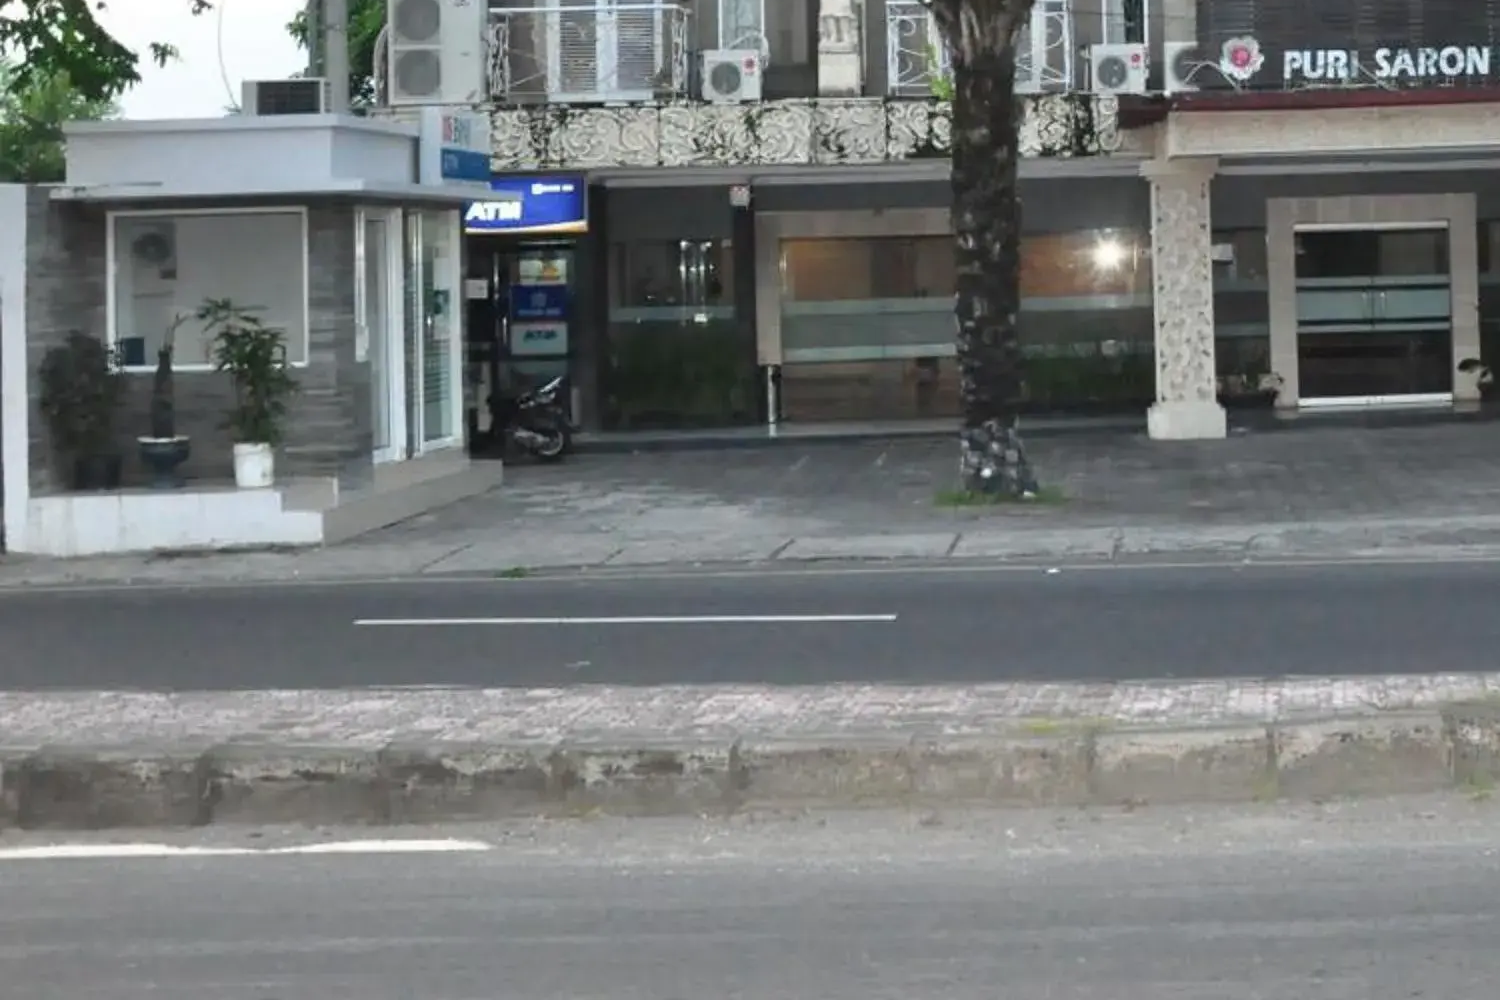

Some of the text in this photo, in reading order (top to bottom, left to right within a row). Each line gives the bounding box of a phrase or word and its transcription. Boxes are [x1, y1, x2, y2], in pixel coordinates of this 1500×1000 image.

[1283, 49, 1359, 79] PURI
[1375, 47, 1489, 77] SARON
[465, 201, 522, 220] ATM
